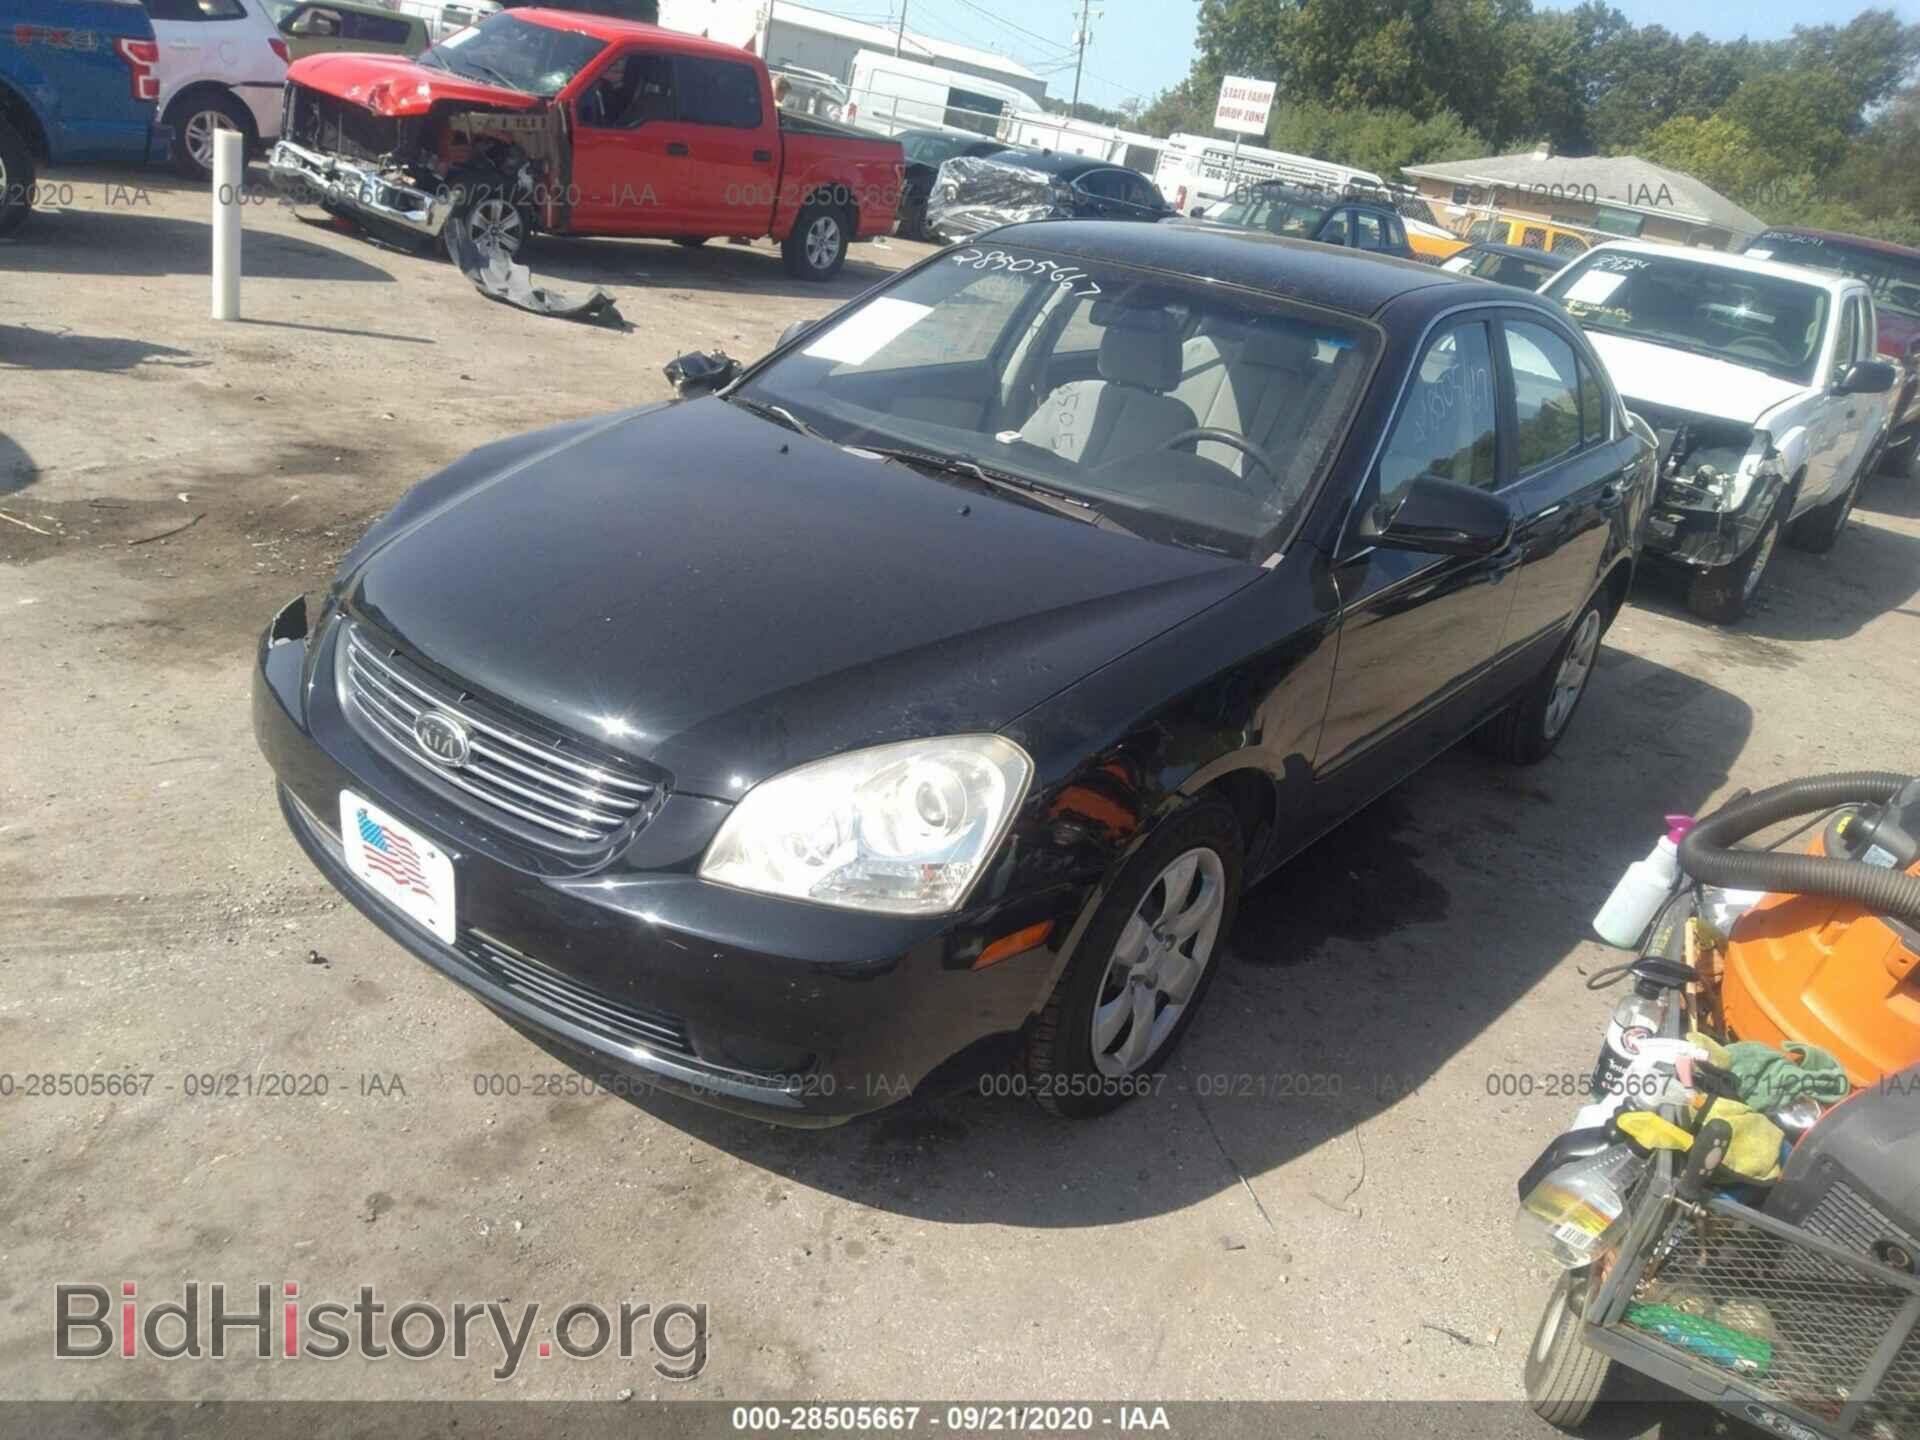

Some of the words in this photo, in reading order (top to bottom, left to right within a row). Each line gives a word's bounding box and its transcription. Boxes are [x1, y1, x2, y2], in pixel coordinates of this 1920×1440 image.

[1223, 86, 1247, 100] STATE
[1247, 89, 1271, 105] FARM
[1218, 106, 1243, 120] DROP
[1244, 110, 1266, 124] ZONE
[952, 249, 1101, 296] 28505667
[420, 726, 455, 758] KIA
